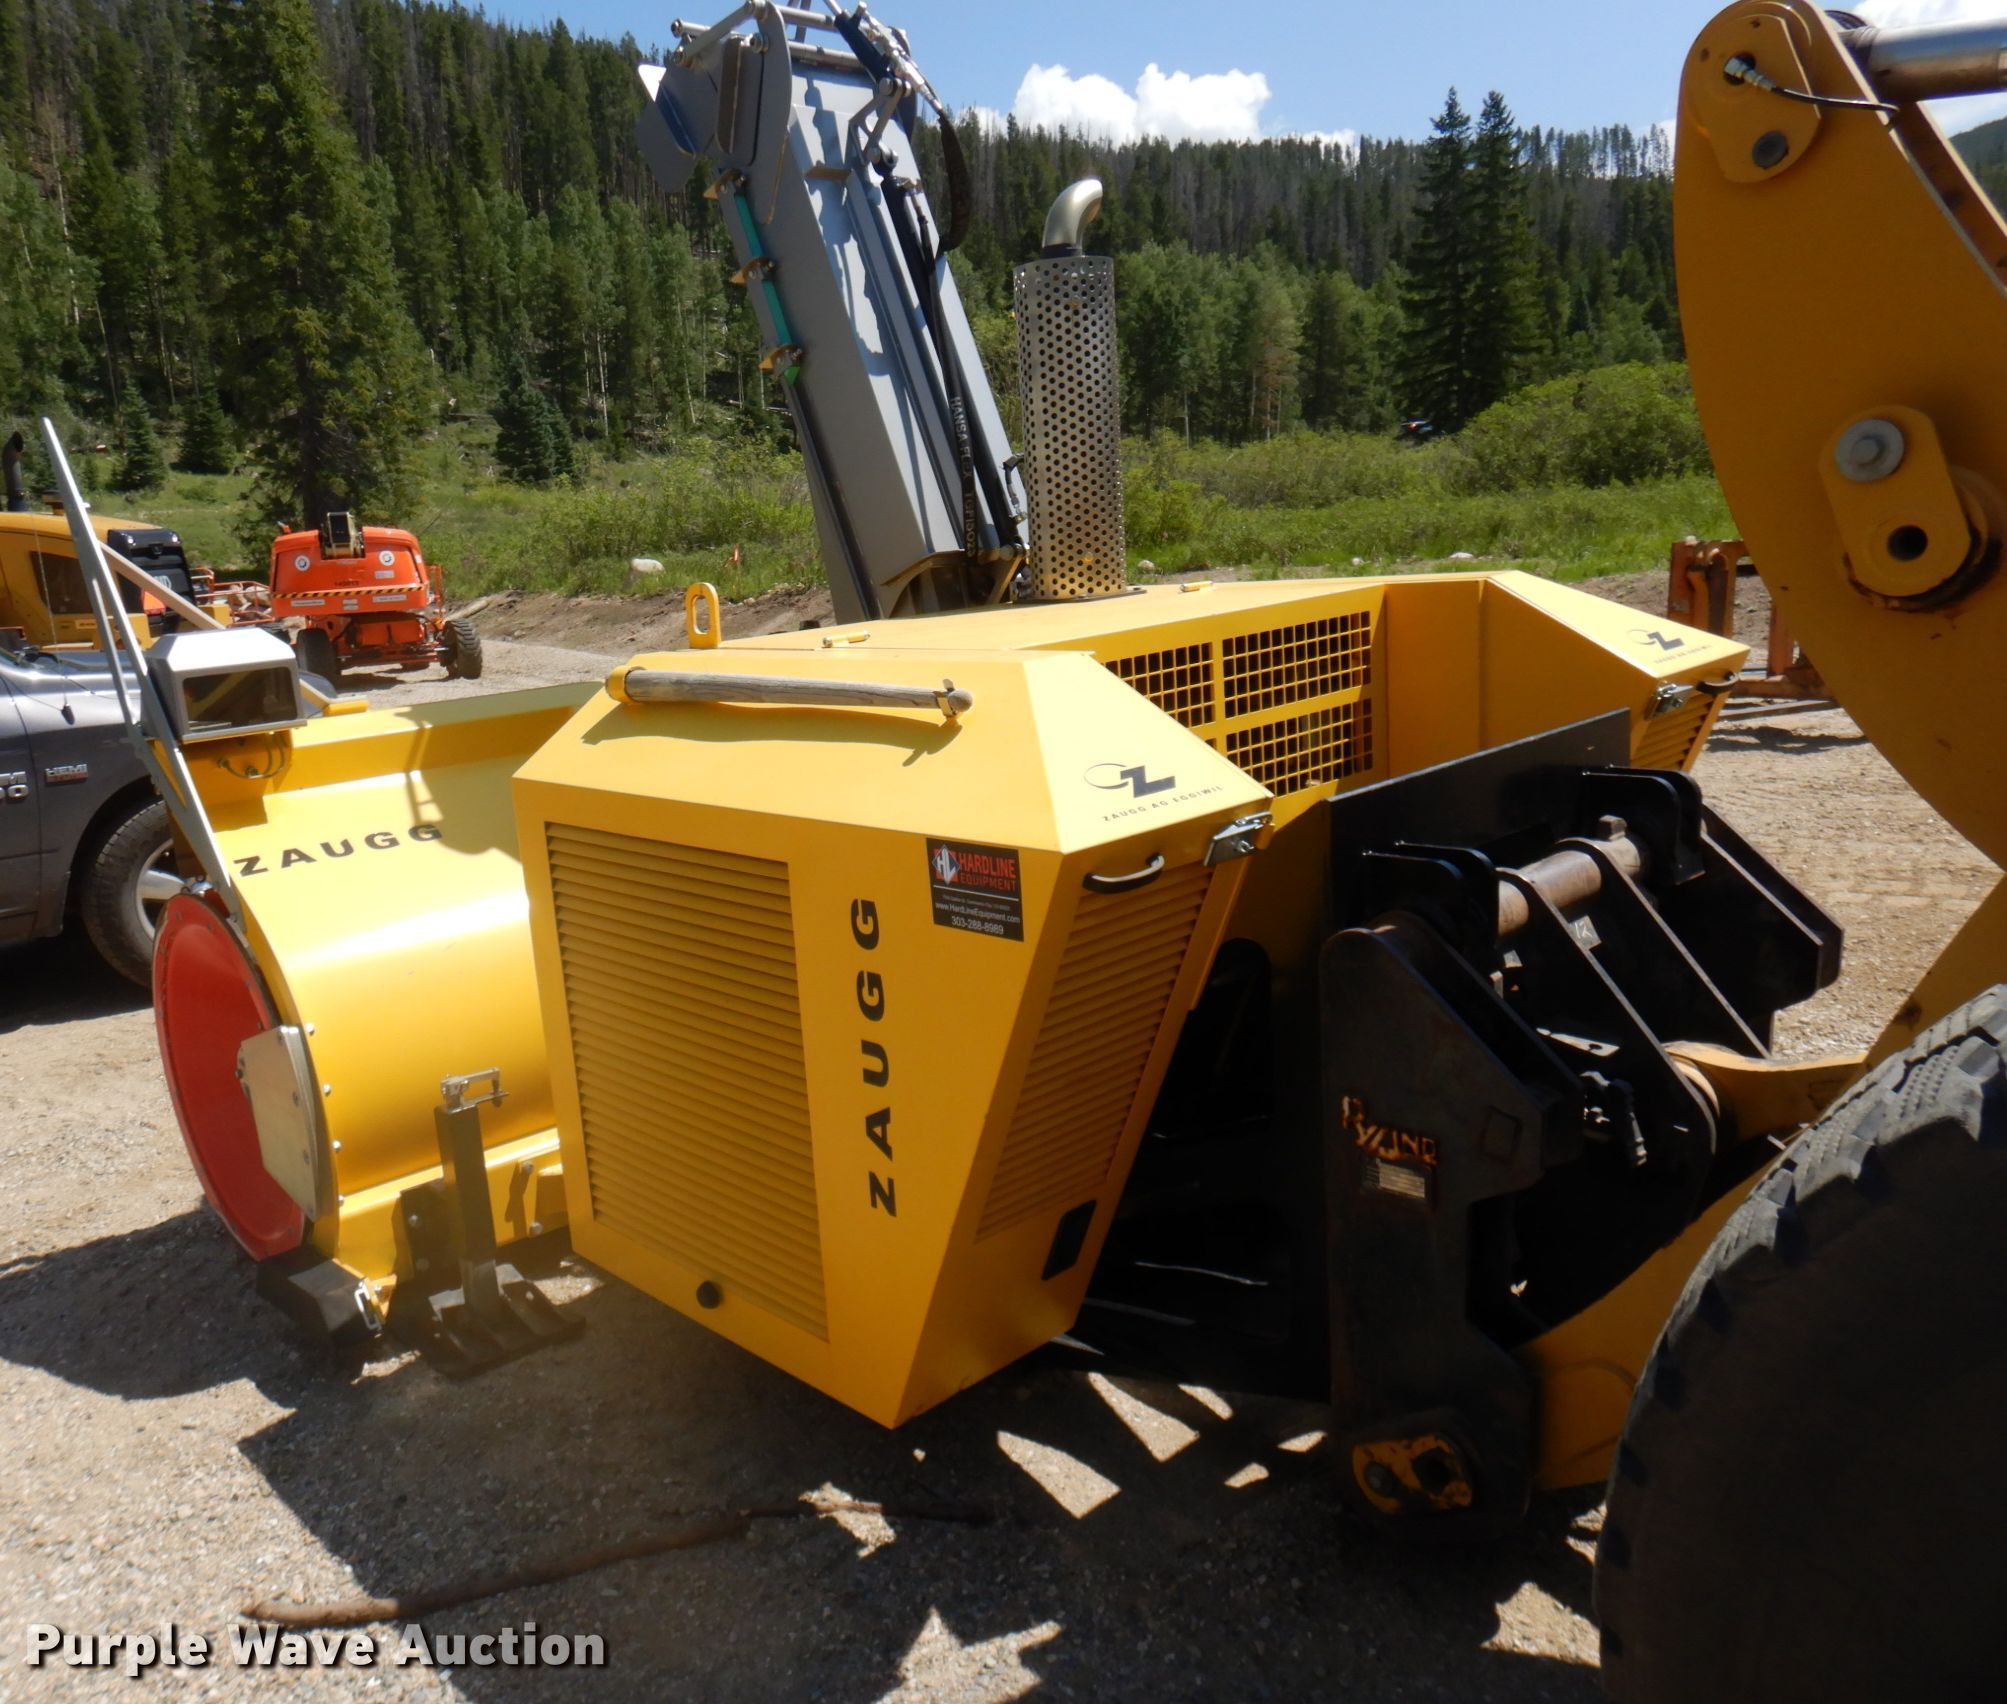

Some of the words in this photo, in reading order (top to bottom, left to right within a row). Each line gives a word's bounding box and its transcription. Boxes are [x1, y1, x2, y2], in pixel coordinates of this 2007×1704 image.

[950, 397, 968, 441] HANSA
[1102, 806, 1147, 822] ZAUGG
[1151, 800, 1169, 809] AG
[233, 824, 443, 877] ZAUGG
[960, 852, 1017, 879] HARDLINE
[960, 872, 1017, 892] EQUIPMENT
[850, 898, 897, 1218] ZAUGG
